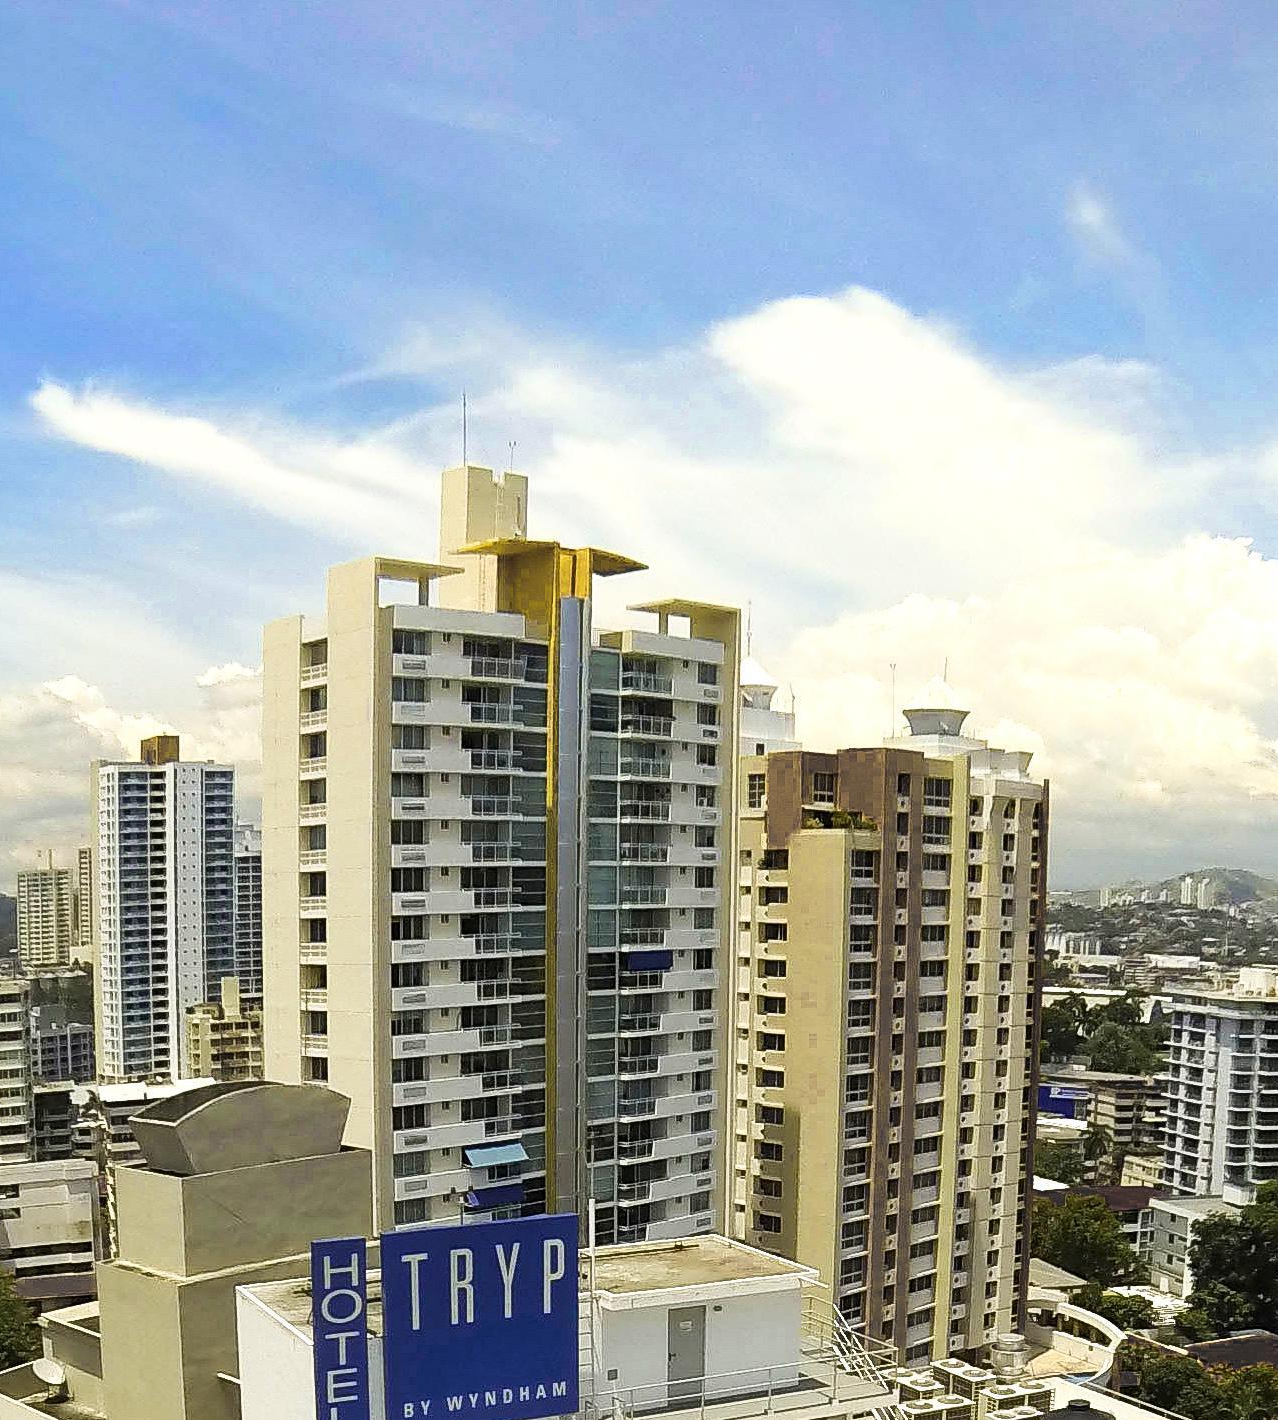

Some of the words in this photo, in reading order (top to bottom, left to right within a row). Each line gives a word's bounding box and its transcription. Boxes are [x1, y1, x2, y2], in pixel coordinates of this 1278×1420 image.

[401, 1239, 566, 1331] TRYP
[403, 1399, 431, 1419] BY
[446, 1381, 568, 1412] WYNDHAM
